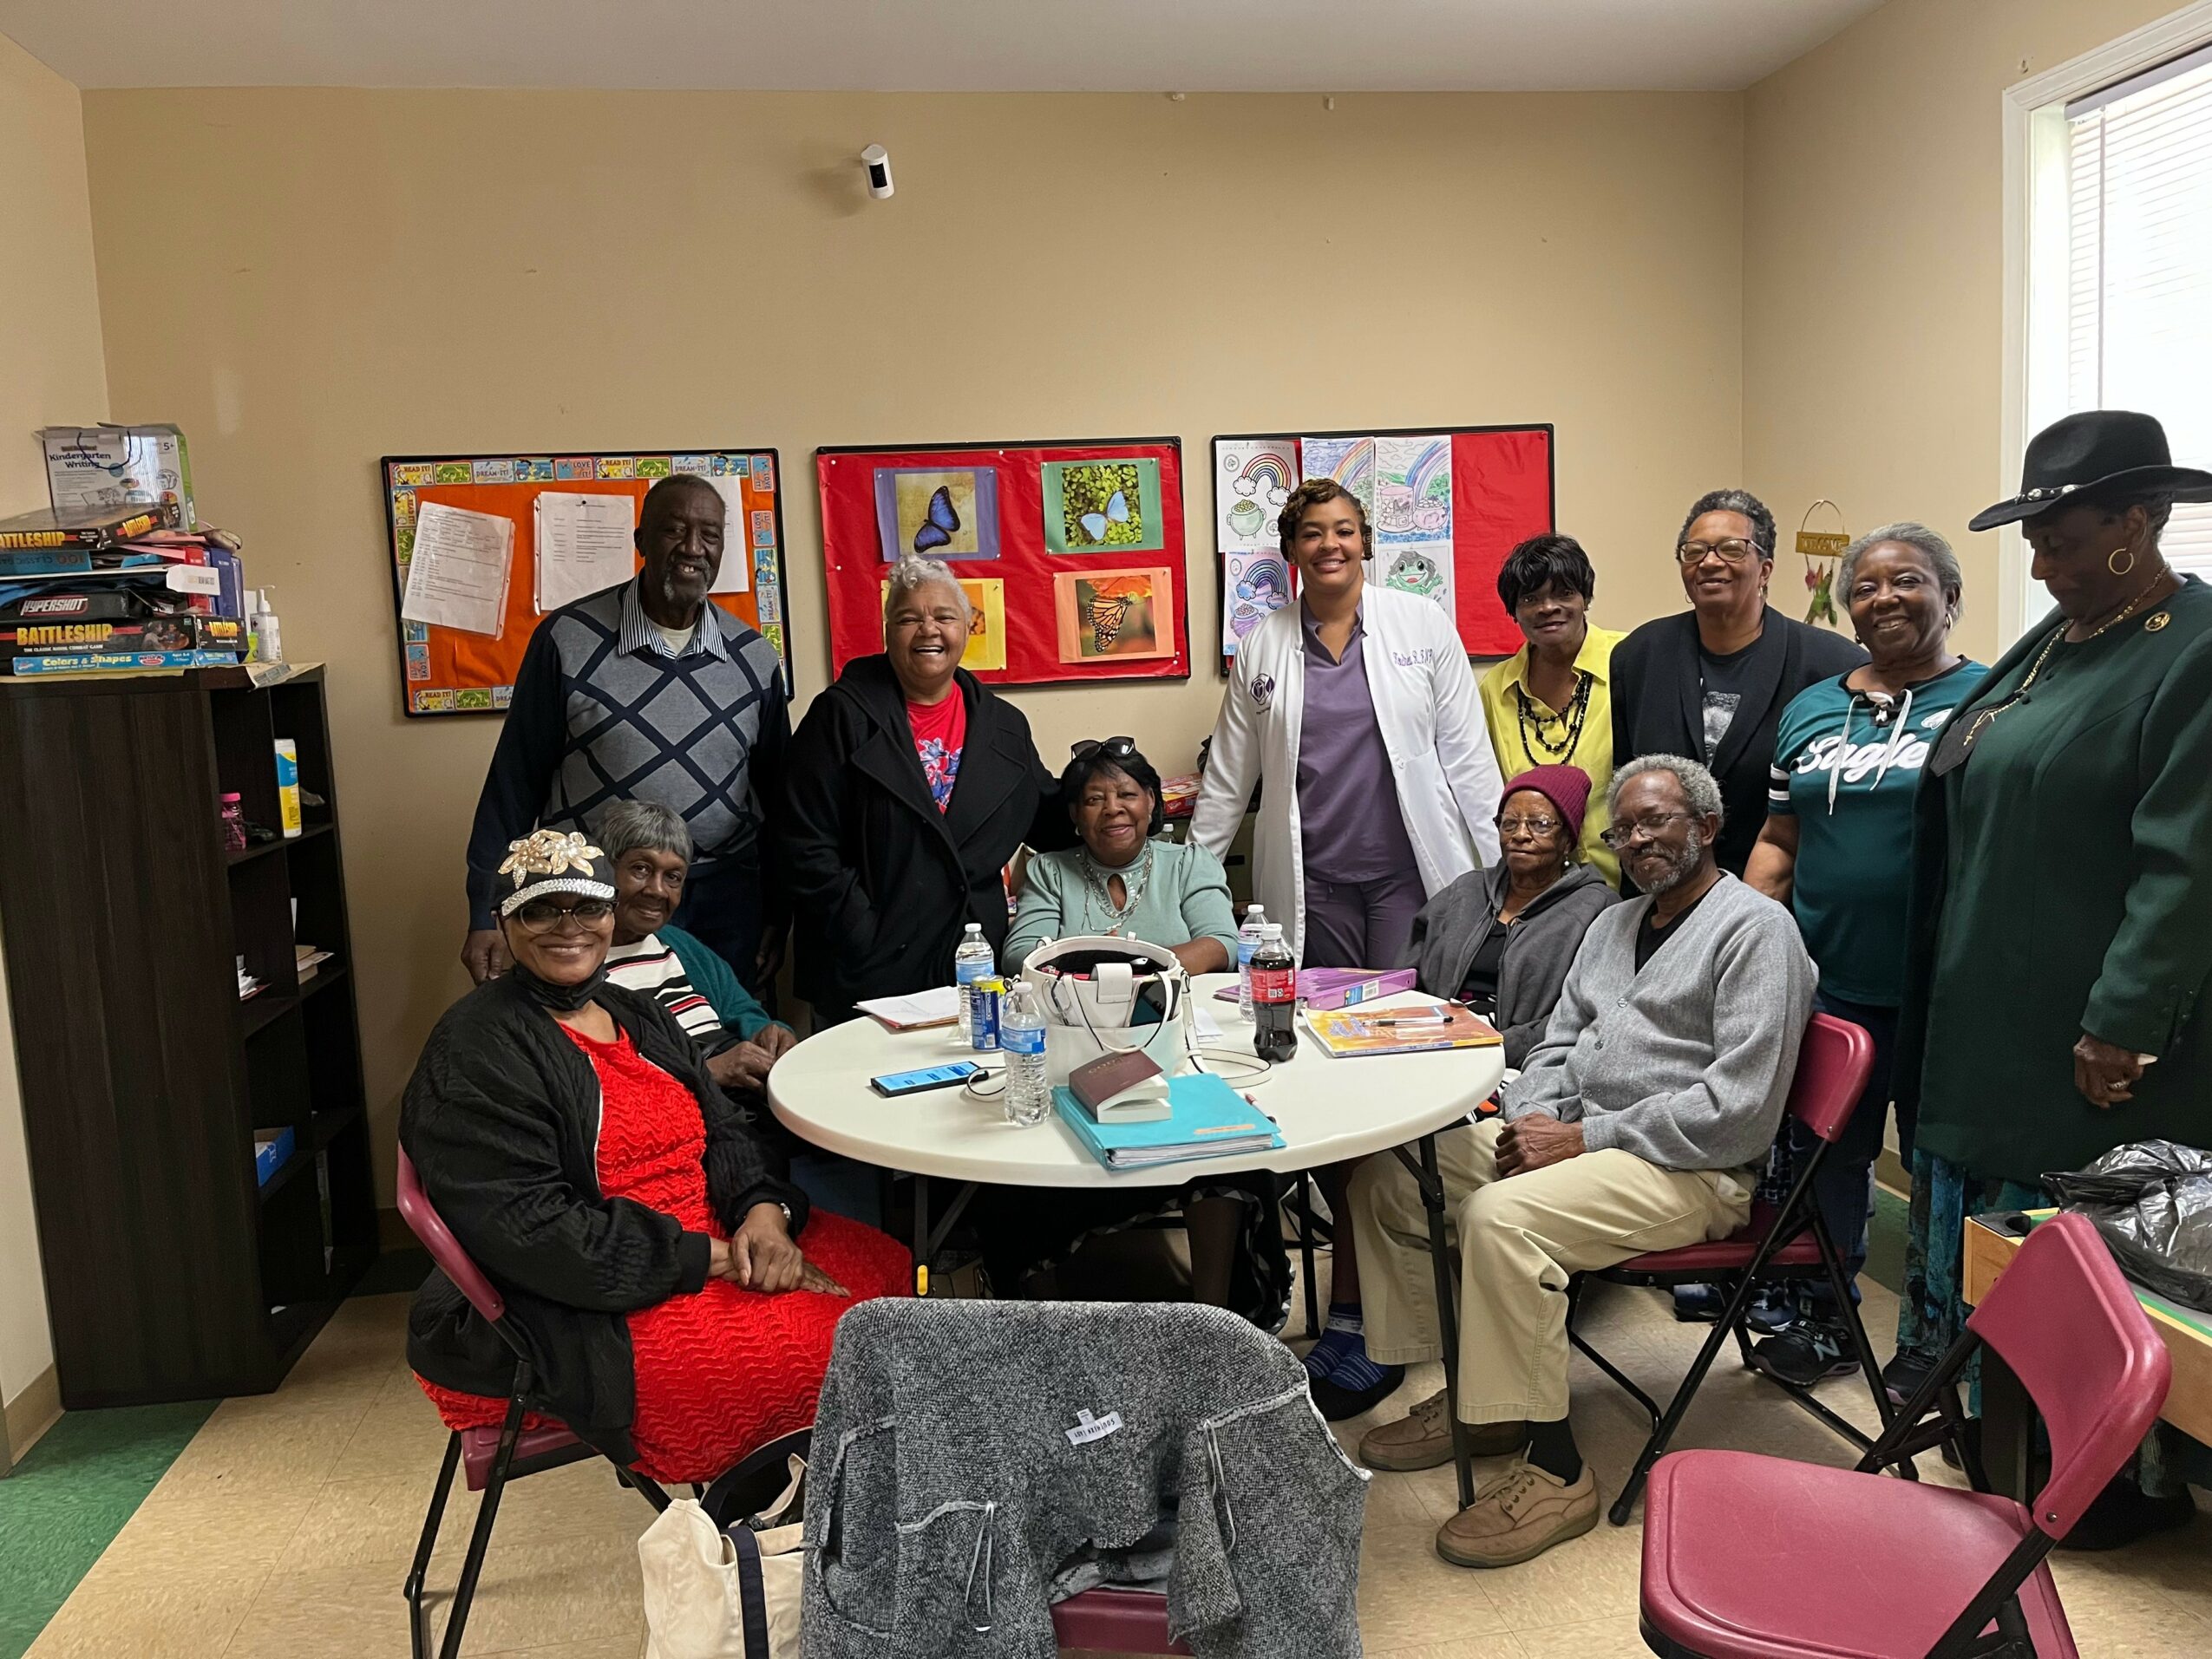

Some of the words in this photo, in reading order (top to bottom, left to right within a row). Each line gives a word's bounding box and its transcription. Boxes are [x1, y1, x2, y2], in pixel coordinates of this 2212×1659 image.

[163, 442, 174, 451] 5+
[49, 452, 112, 461] Kindergarten
[65, 460, 100, 469] Writing
[0, 531, 66, 549] ATTLESHIP
[21, 598, 88, 617] HYPERSHOT
[17, 623, 113, 646] BATTLESHIP
[42, 657, 79, 667] Colors
[90, 654, 133, 665] Shapes
[1798, 734, 1932, 783] Eagle
